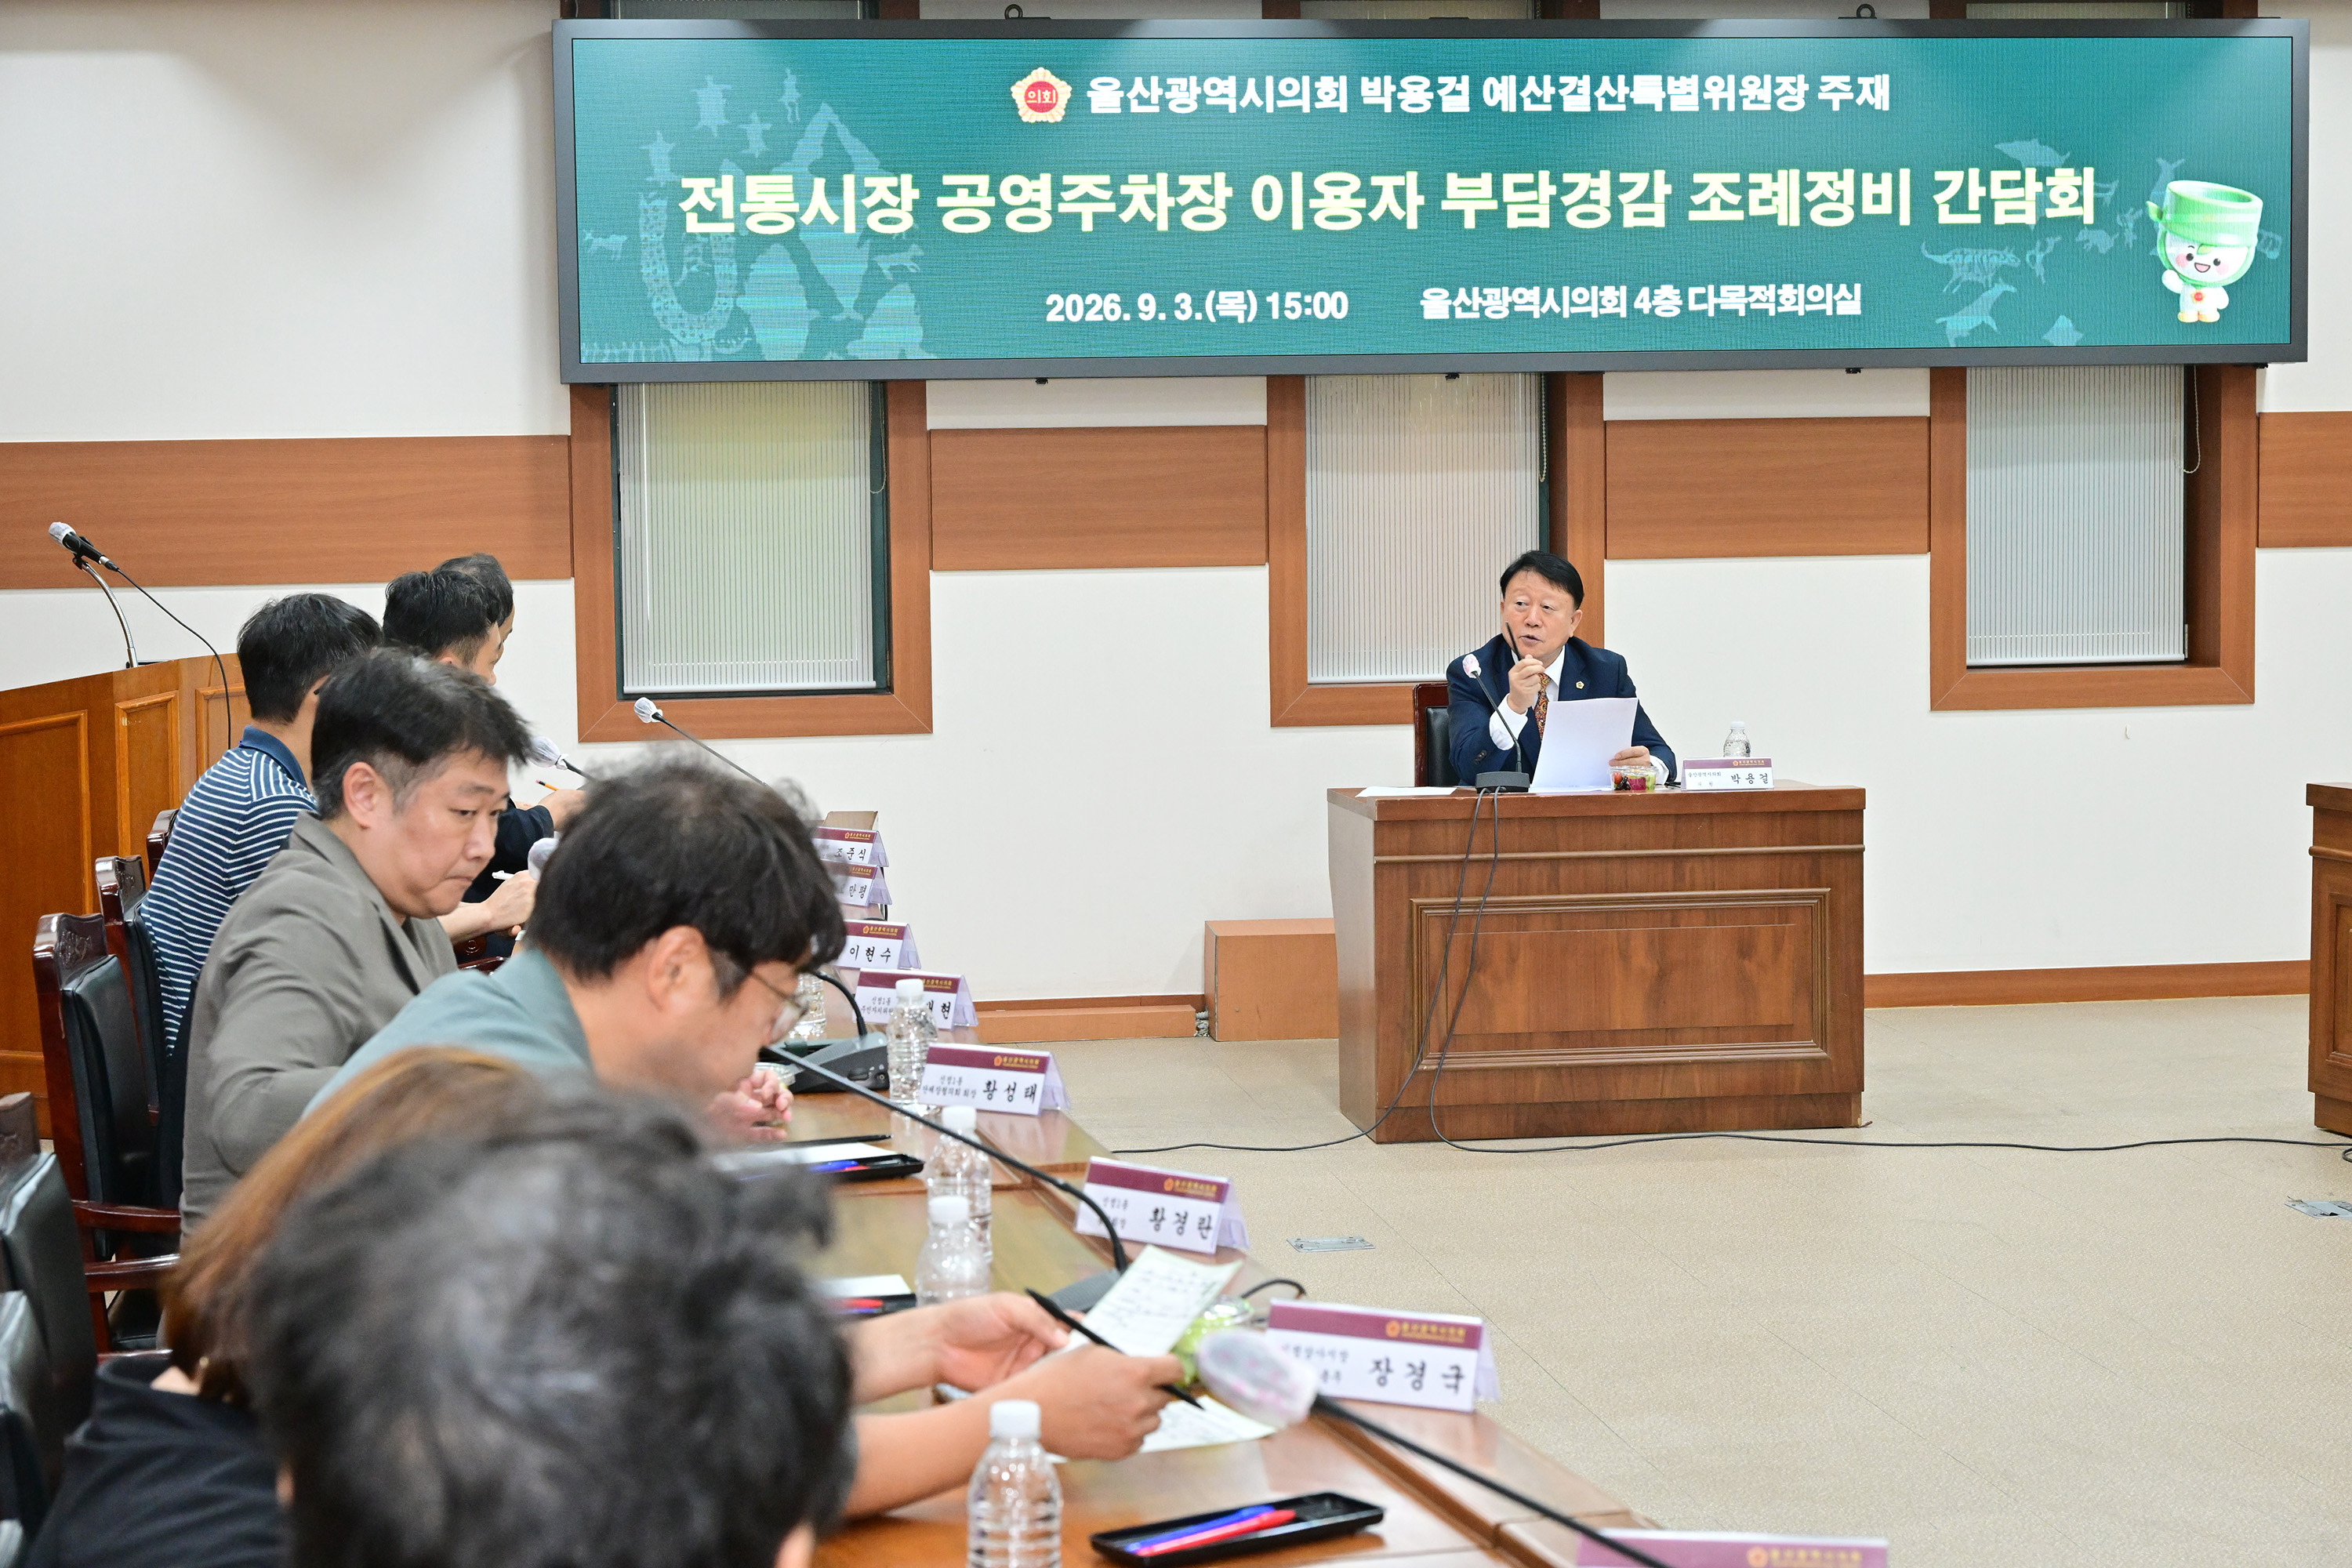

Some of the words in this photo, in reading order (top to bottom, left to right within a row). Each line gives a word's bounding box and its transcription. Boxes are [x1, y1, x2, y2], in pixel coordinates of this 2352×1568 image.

[1026, 89, 1056, 103] 의회
[1087, 75, 1348, 114] 울산광역시의회
[1361, 74, 1470, 113] 박용걸
[1483, 74, 1809, 112] 예산결산특별위원장
[1817, 74, 1890, 111] 주재
[678, 174, 920, 234] 전통시장
[937, 172, 1233, 234] 공영주차장
[1251, 171, 1425, 230] 이용자
[1441, 169, 1672, 229] 부담경감
[1688, 168, 1911, 227] 조례정비
[1933, 167, 2094, 225] 간담회
[1046, 293, 1131, 322] 2026.
[1138, 292, 1166, 321] 9.
[1174, 289, 1258, 324] 3.(목)
[1266, 291, 1348, 320] 15:00
[1420, 285, 1627, 319] 울산광역시의회
[1634, 285, 1682, 318] 4층
[1688, 283, 1862, 317] 다목적회의실
[1731, 773, 1769, 785] 박용걸
[834, 848, 866, 861] 조준식
[850, 945, 891, 964] 이현수
[982, 1080, 1037, 1104] 황성태
[1149, 1207, 1214, 1240] 황경란
[1368, 1356, 1465, 1396] 장경국
